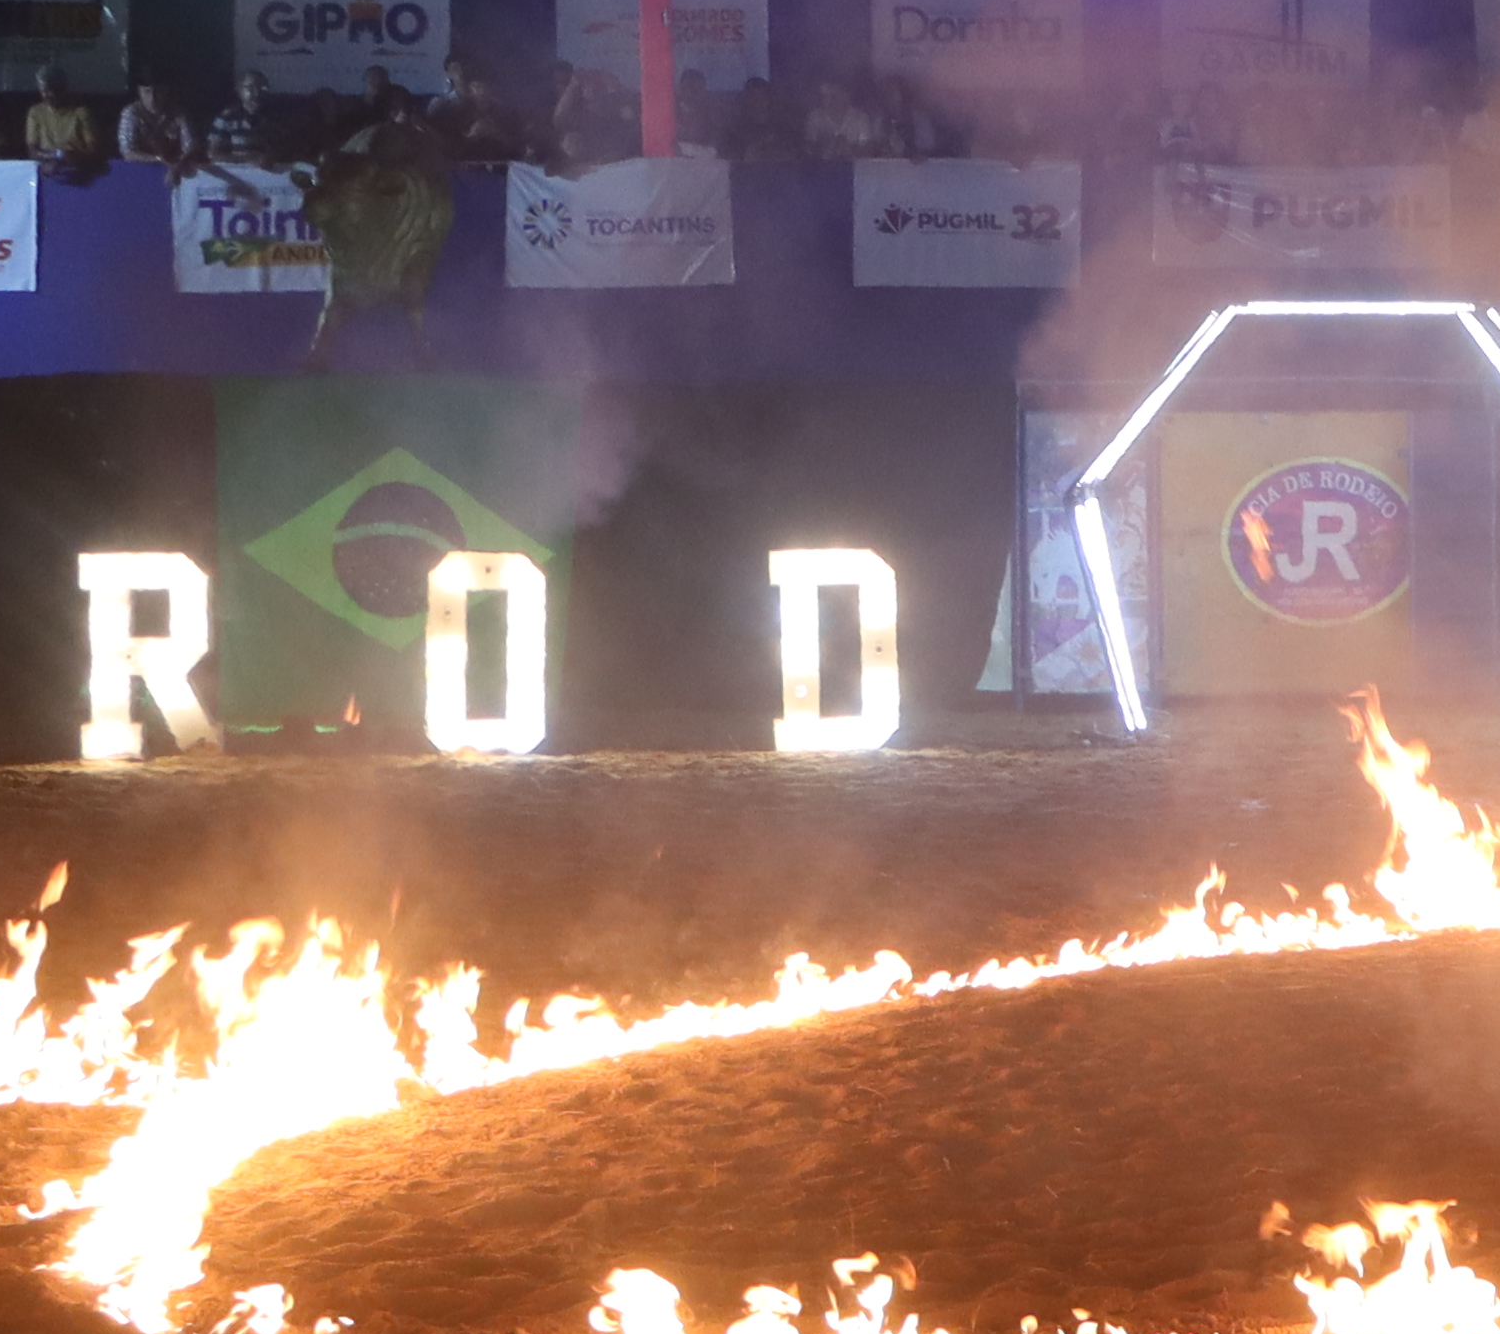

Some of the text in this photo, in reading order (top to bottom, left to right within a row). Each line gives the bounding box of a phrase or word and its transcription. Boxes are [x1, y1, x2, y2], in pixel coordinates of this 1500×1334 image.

[586, 217, 716, 236] TOCANTINS
[918, 204, 1062, 240] PUGMIL 32
[1253, 193, 1444, 230] PUGMIL
[1248, 470, 1398, 519] CIA DE RODEIO
